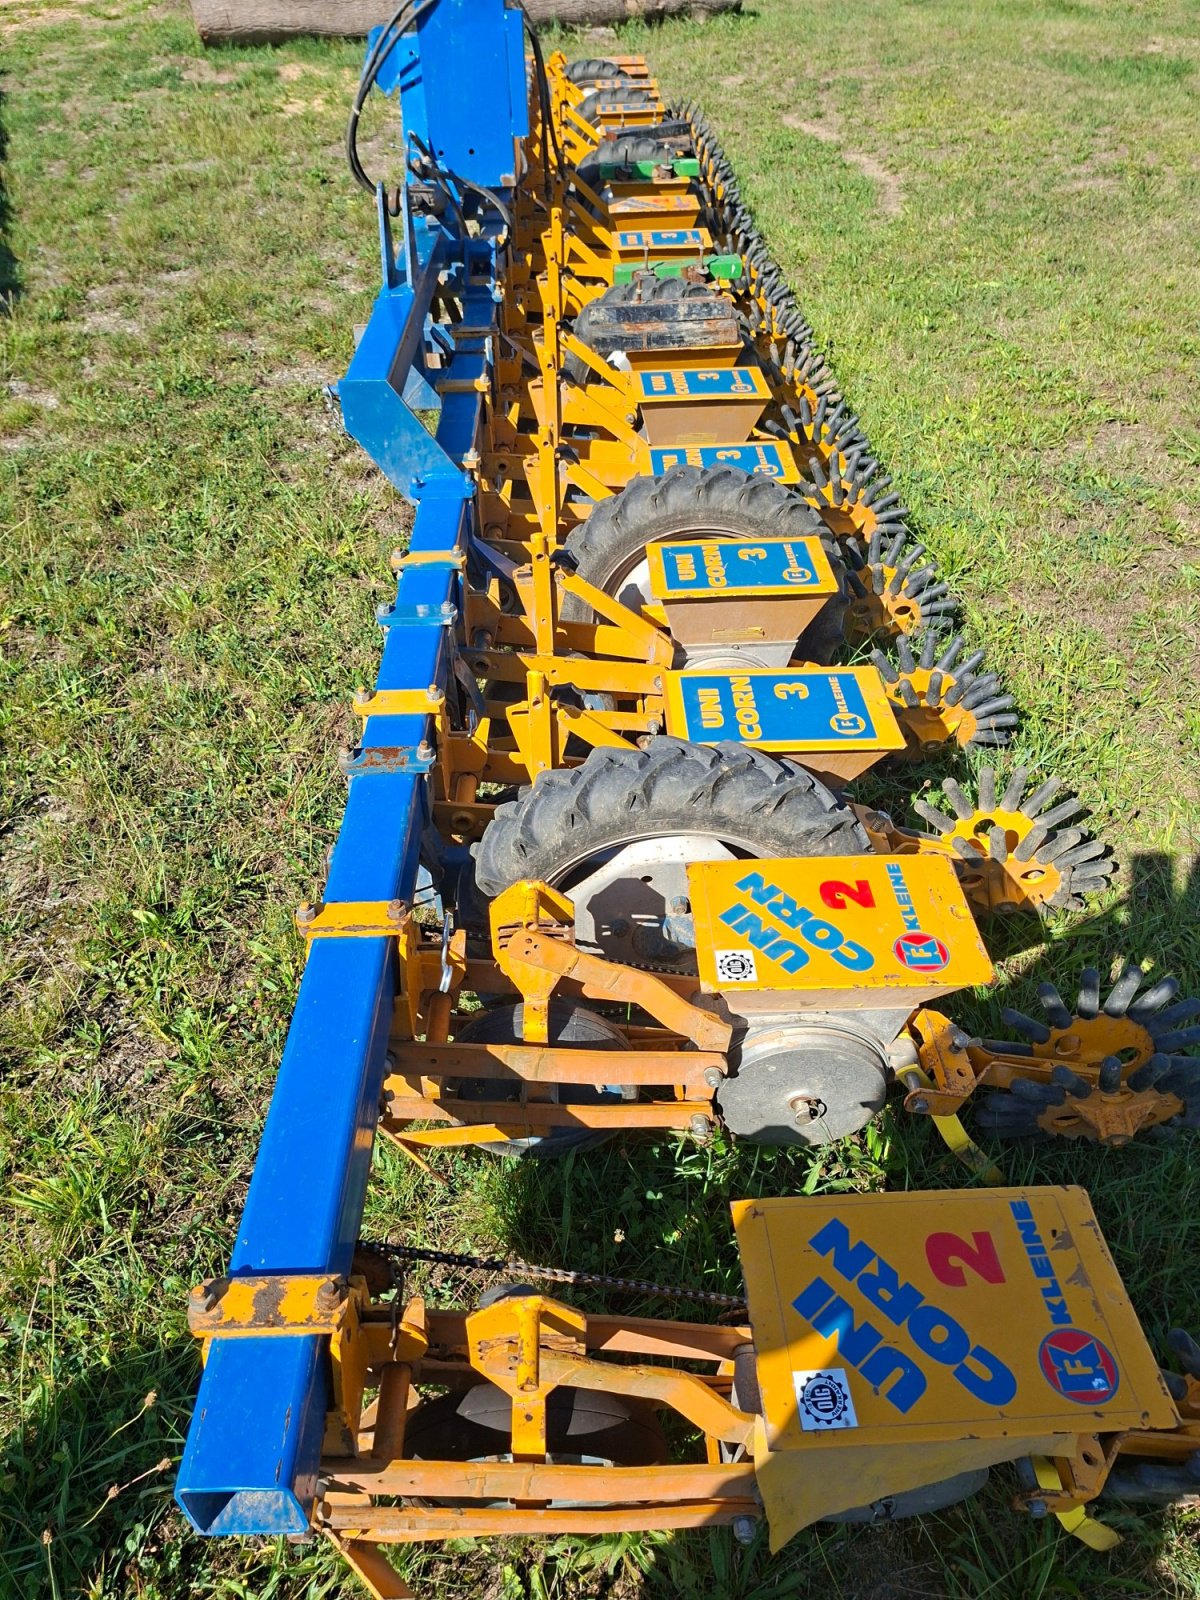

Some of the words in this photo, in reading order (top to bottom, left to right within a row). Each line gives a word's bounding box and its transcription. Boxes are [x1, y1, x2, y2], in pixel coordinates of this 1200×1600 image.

[698, 372, 719, 381] 3
[716, 450, 741, 460] 3
[675, 553, 697, 581] UNI
[702, 544, 727, 588] CORN
[738, 548, 767, 560] 3
[782, 543, 799, 569] KLEINE
[698, 688, 725, 728] UNI
[730, 677, 762, 740] CORN
[774, 682, 809, 700] 3
[828, 676, 848, 713] KLEINE
[819, 880, 876, 909] 2
[885, 863, 921, 932] KLEINE
[718, 903, 810, 974] UNI
[734, 872, 875, 973] CORN
[925, 1231, 1006, 1288] 2
[1009, 1200, 1073, 1325] KLEINE
[807, 1217, 1017, 1407] CORN
[791, 1276, 927, 1415] UNI
